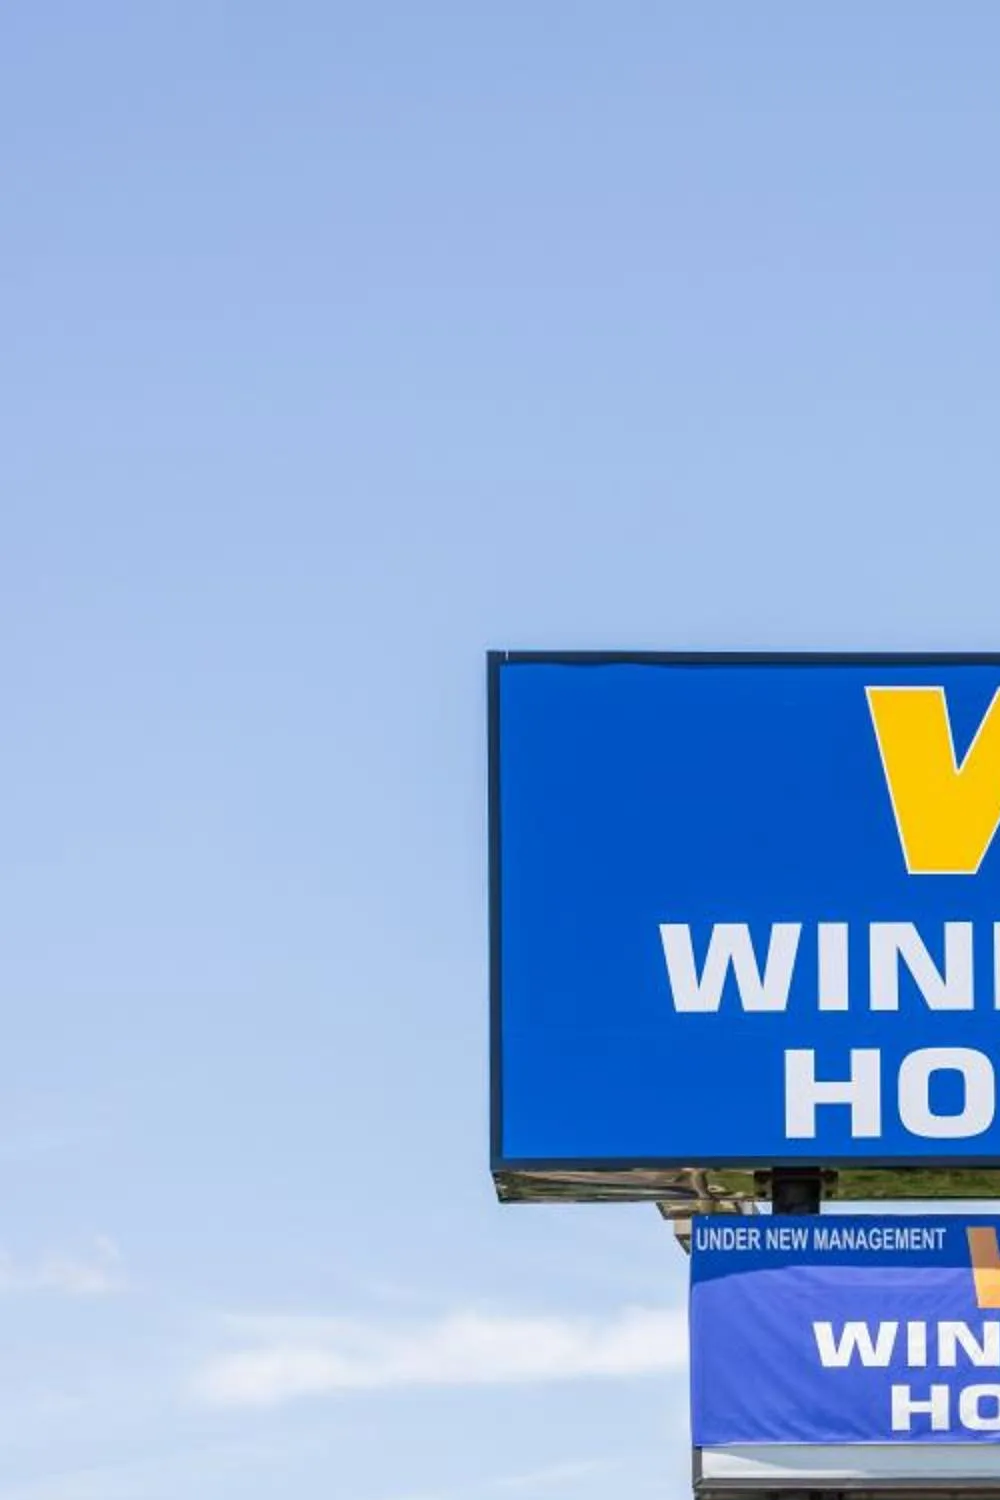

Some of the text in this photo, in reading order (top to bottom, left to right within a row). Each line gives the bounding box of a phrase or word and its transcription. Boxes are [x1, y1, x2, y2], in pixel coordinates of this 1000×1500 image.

[696, 1227, 946, 1250] UNDER NEW MANAGEMENT
